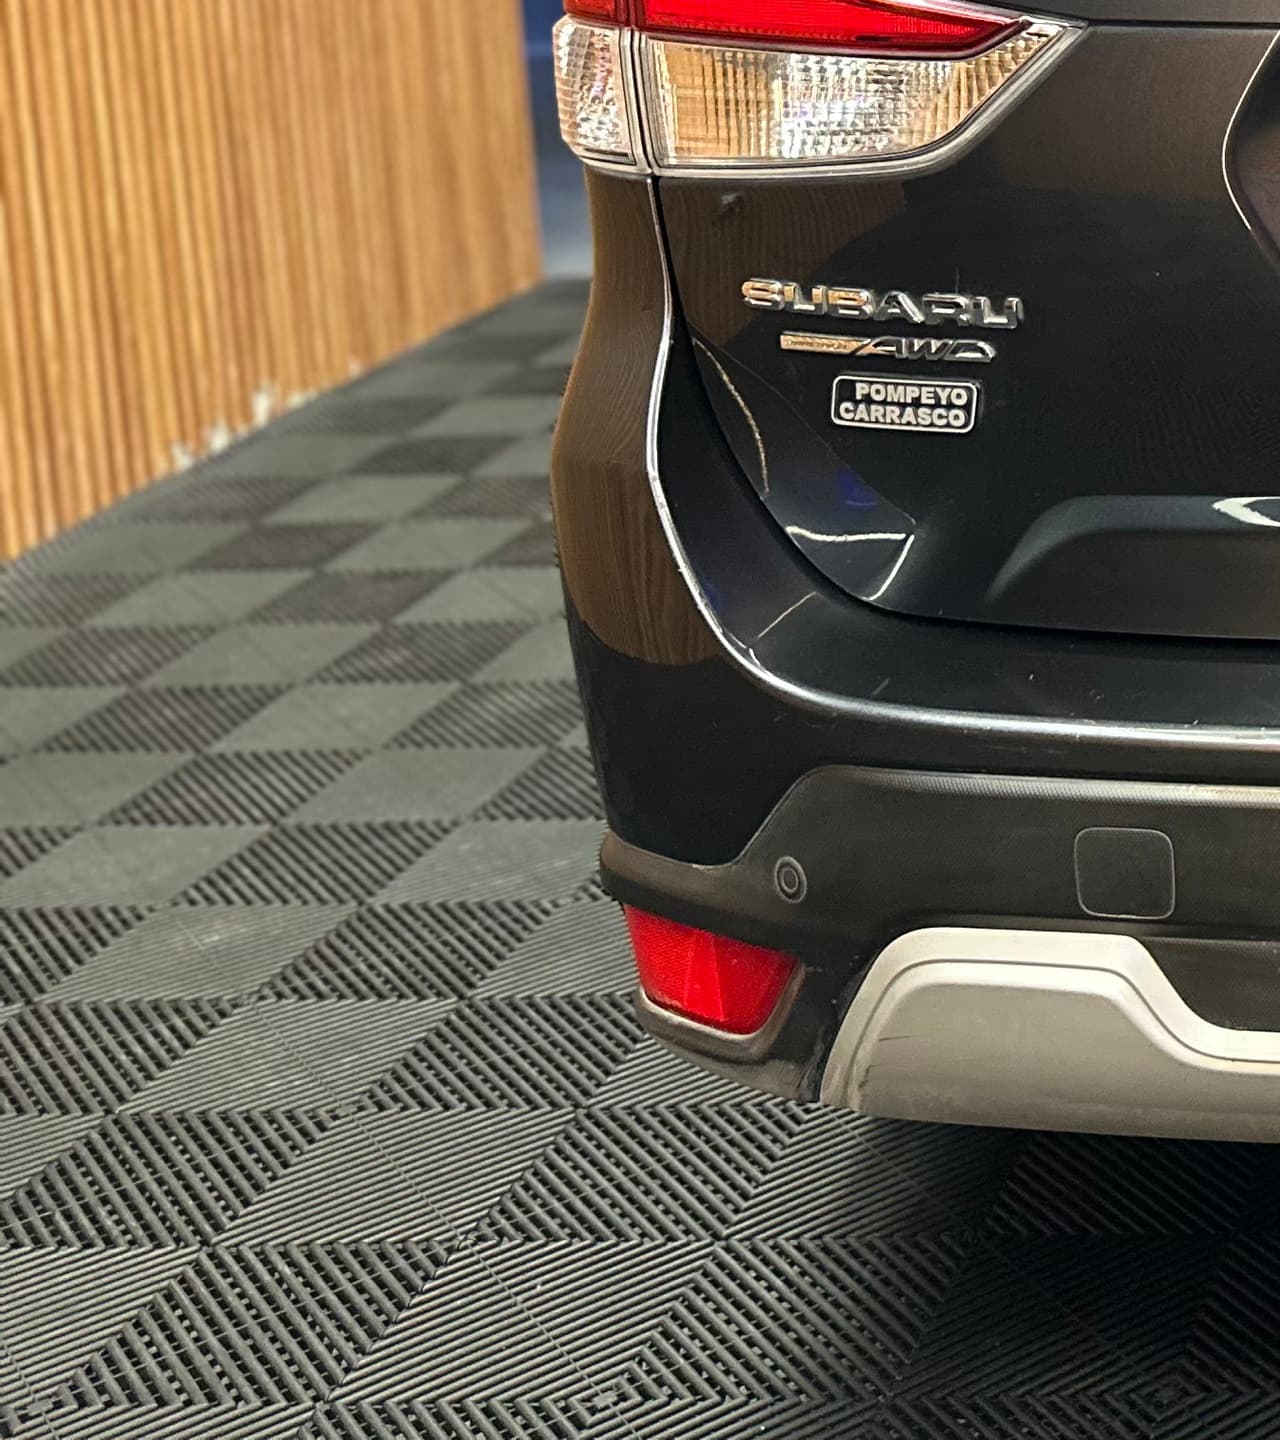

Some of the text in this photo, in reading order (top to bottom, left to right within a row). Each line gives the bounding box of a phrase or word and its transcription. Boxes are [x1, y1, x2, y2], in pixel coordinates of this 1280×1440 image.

[741, 277, 1025, 329] SUBARU
[852, 334, 998, 362] AWD
[854, 381, 969, 406] POMPEYO
[838, 402, 967, 428] CARRASCO
